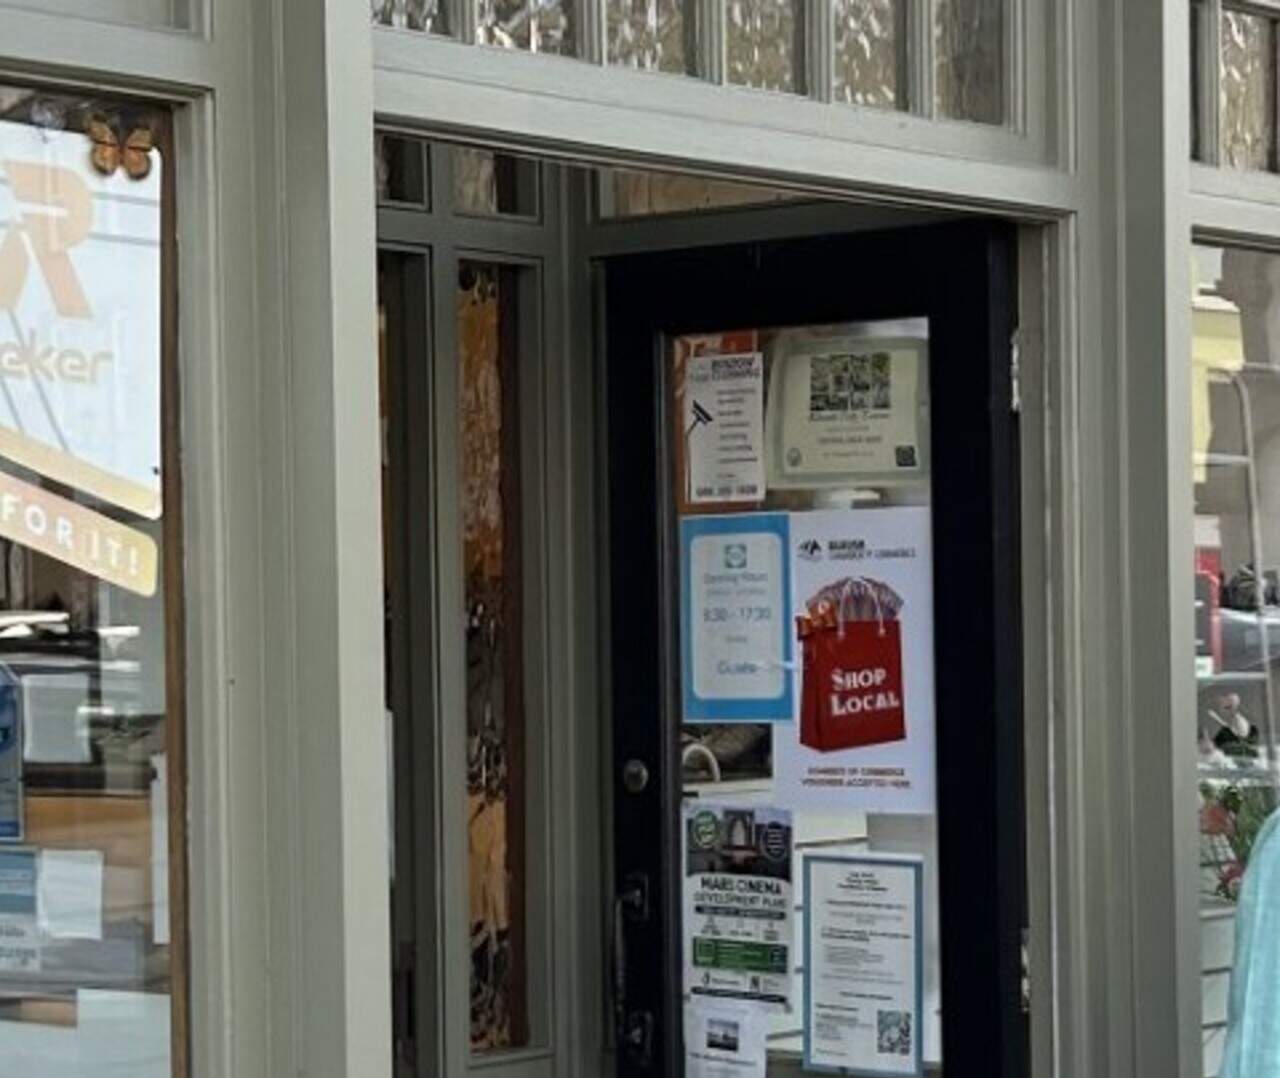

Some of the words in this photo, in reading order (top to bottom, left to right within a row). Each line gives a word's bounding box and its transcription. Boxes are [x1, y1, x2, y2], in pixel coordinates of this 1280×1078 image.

[1, 492, 75, 550] FOR
[90, 530, 138, 576] IT!
[831, 668, 887, 691] SHOP
[831, 691, 899, 716] LOCAL
